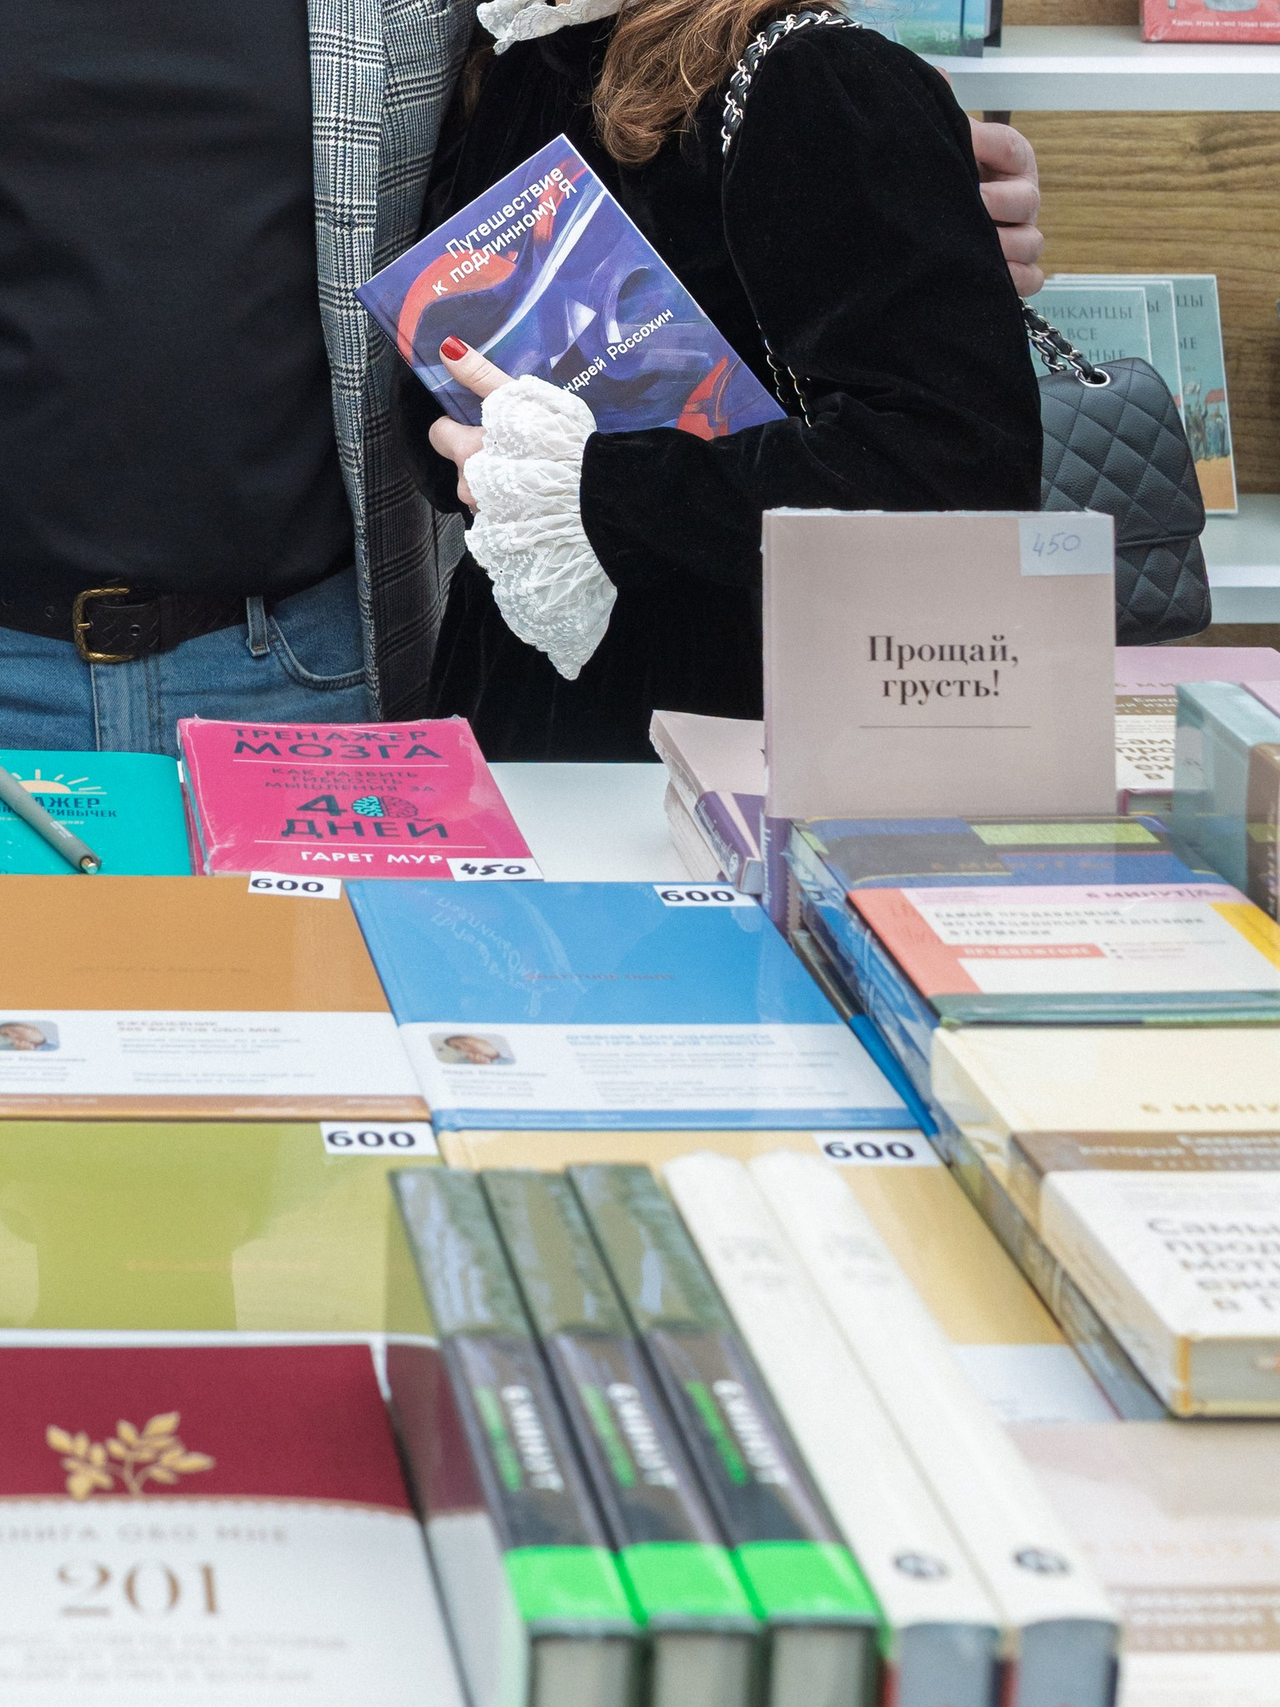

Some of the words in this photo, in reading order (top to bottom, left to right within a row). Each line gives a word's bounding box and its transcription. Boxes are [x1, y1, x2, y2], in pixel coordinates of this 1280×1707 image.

[446, 166, 565, 260] Путешествие
[449, 198, 559, 284] подлинному
[559, 177, 578, 202] Я
[1041, 305, 1133, 321] РИКАНЦЫ
[562, 356, 608, 395] ндрей
[607, 307, 675, 362] Россохин
[1032, 532, 1082, 557] 450
[867, 634, 1019, 670] Прощай,
[881, 668, 1002, 706] грусть!
[230, 728, 428, 743] ТРЕНАЖЕР
[232, 740, 443, 761] МОЗГА
[324, 769, 418, 778] РАЗВИТЬ
[45, 808, 118, 819] РИВЫЧЕК
[280, 817, 450, 840] ДНЕЙ
[300, 850, 375, 863] ГАРЕТ
[386, 853, 444, 865] МУР
[459, 862, 527, 876] 450
[250, 877, 325, 893] 600
[660, 889, 736, 903] 600
[326, 1130, 417, 1148] 600
[822, 1141, 916, 1161] 600
